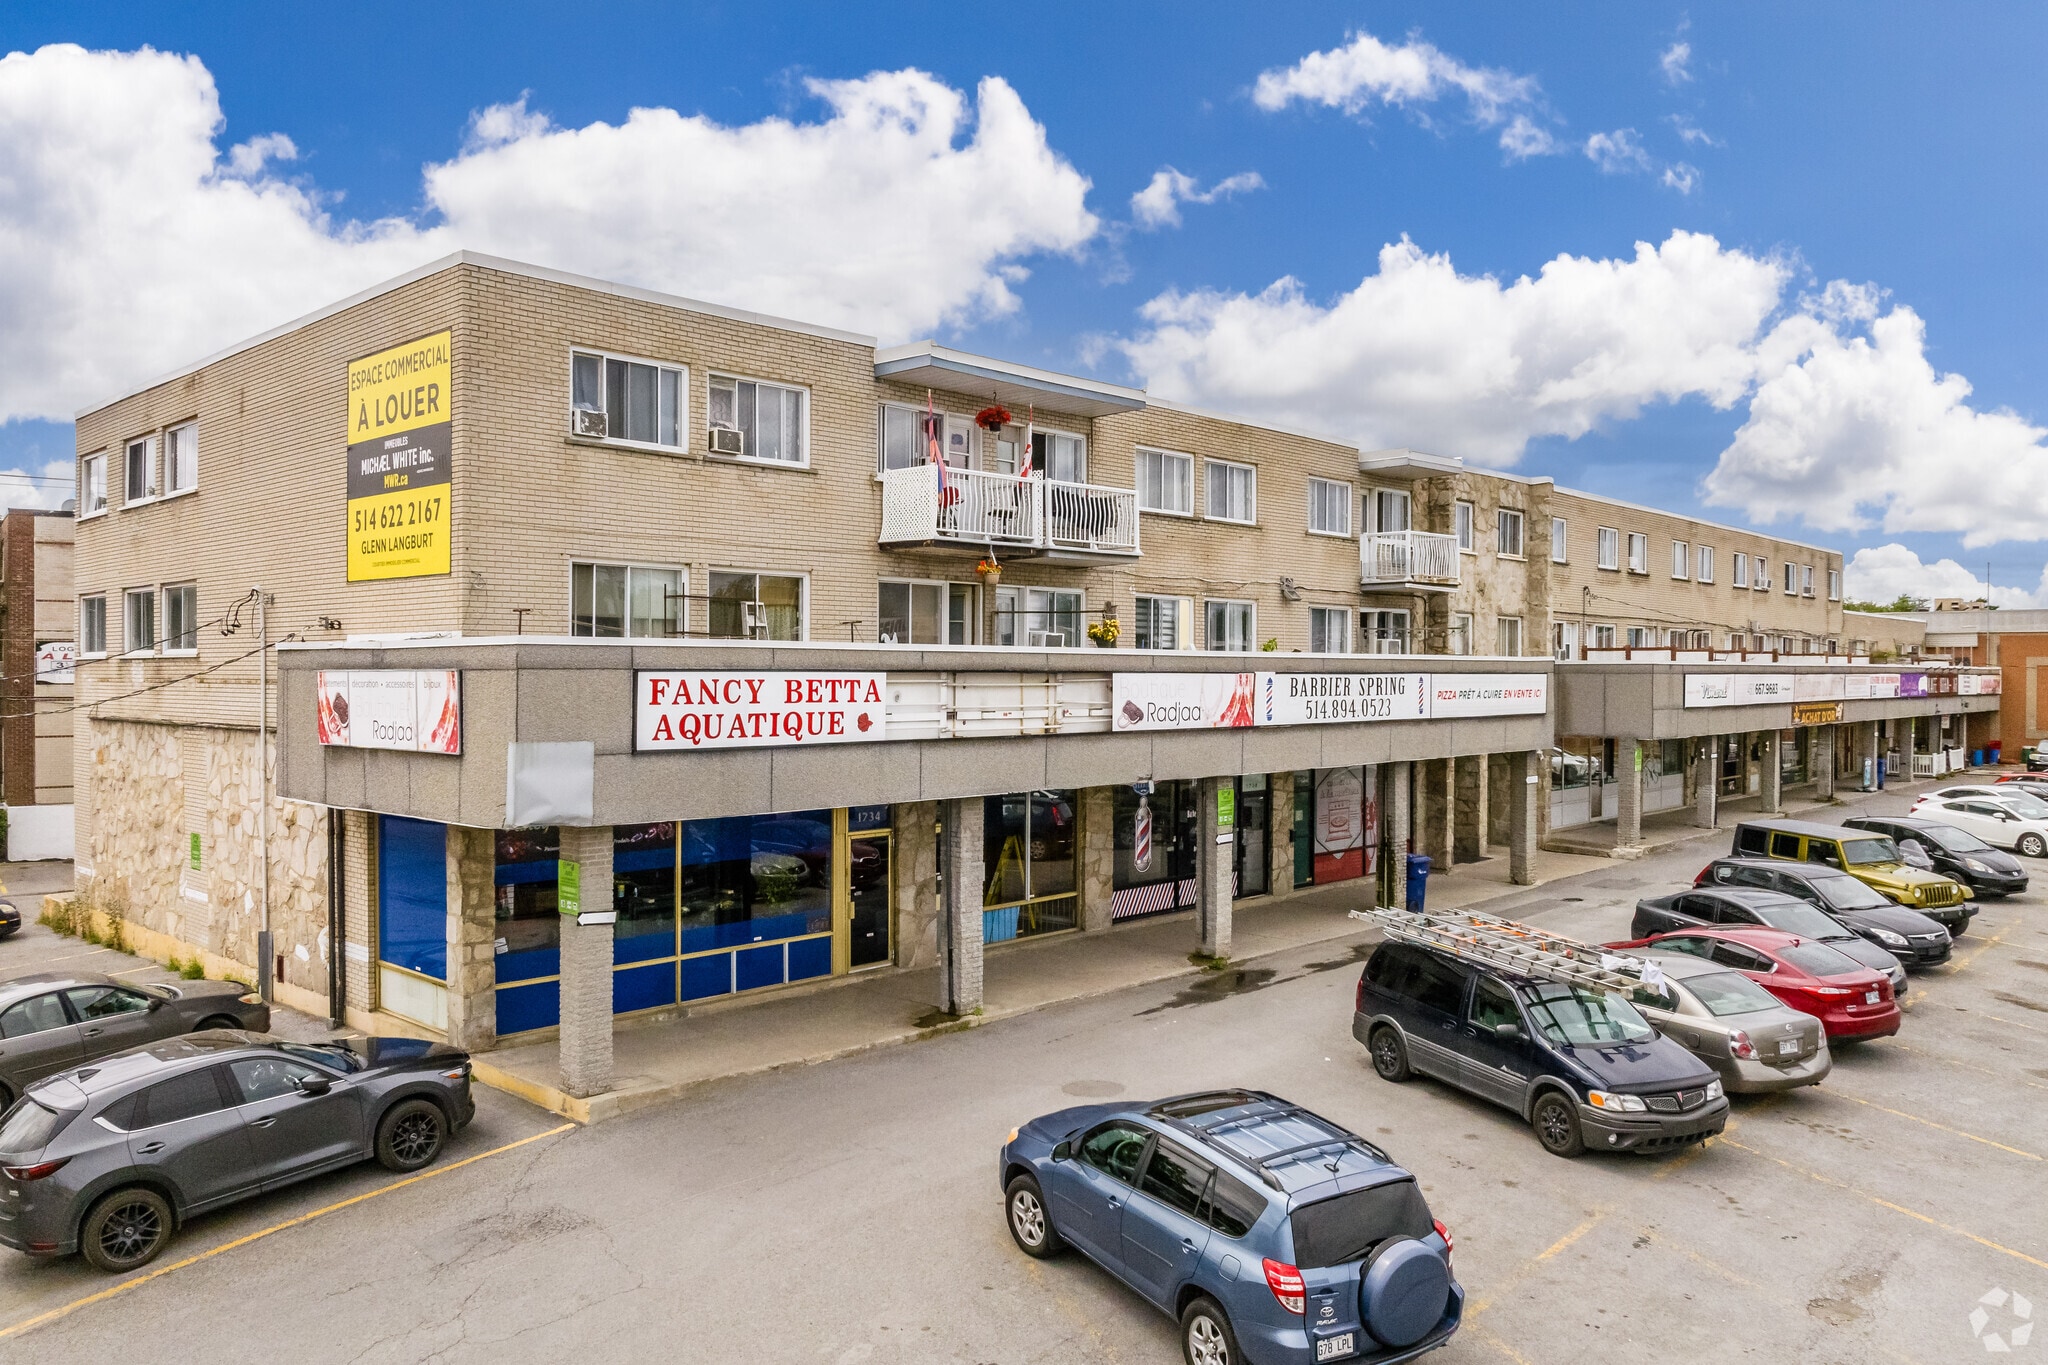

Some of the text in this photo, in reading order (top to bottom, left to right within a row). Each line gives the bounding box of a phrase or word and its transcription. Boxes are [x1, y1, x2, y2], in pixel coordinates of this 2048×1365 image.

[351, 344, 449, 391] ESPACE COMMERCIAL
[357, 383, 439, 432] À LOUER
[392, 448, 418, 470] WHITE
[419, 447, 435, 465] inc.
[383, 474, 409, 489] MWR.ca
[355, 497, 441, 533] 514 622 2167
[361, 532, 434, 555] GLENN LANGBURT
[649, 679, 882, 705] FANCY BETTA
[1290, 676, 1406, 698] BARBIER SPRING
[1437, 690, 1457, 700] PIZZA
[1459, 688, 1475, 700] PRÊT
[1483, 689, 1503, 699] CUIRE
[1504, 689, 1512, 699] EN
[1513, 689, 1532, 699] VENTE
[1146, 702, 1201, 726] Radjaa
[1306, 698, 1392, 719] 514.894.0523
[1801, 710, 1836, 723] ACHAT D'OR
[652, 711, 845, 745] AQUATIQUE
[858, 811, 880, 823] 1734
[1337, 1337, 1352, 1351] LPL
